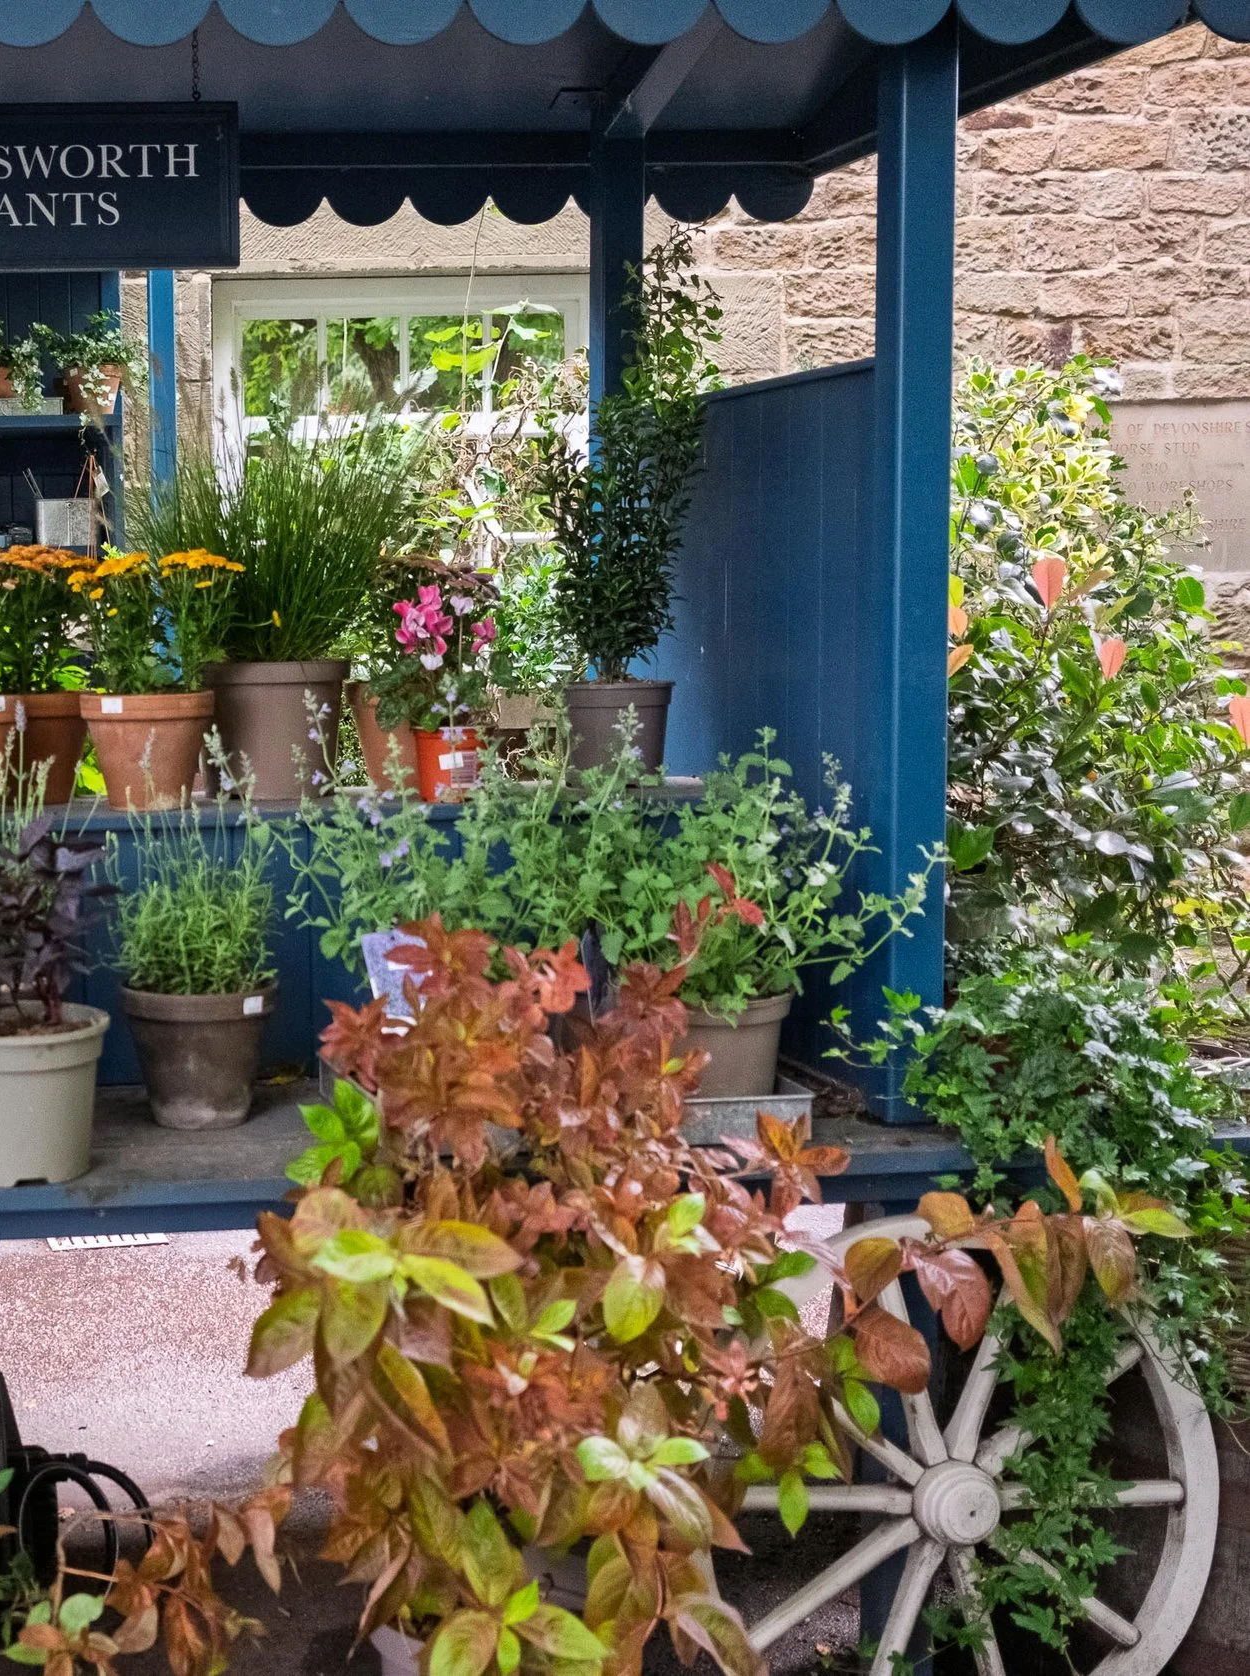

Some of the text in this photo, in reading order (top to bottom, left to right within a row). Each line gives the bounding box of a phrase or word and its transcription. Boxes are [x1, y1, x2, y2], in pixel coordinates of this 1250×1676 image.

[1126, 423, 1144, 436] OF
[1110, 442, 1201, 456] HORSE STUD
